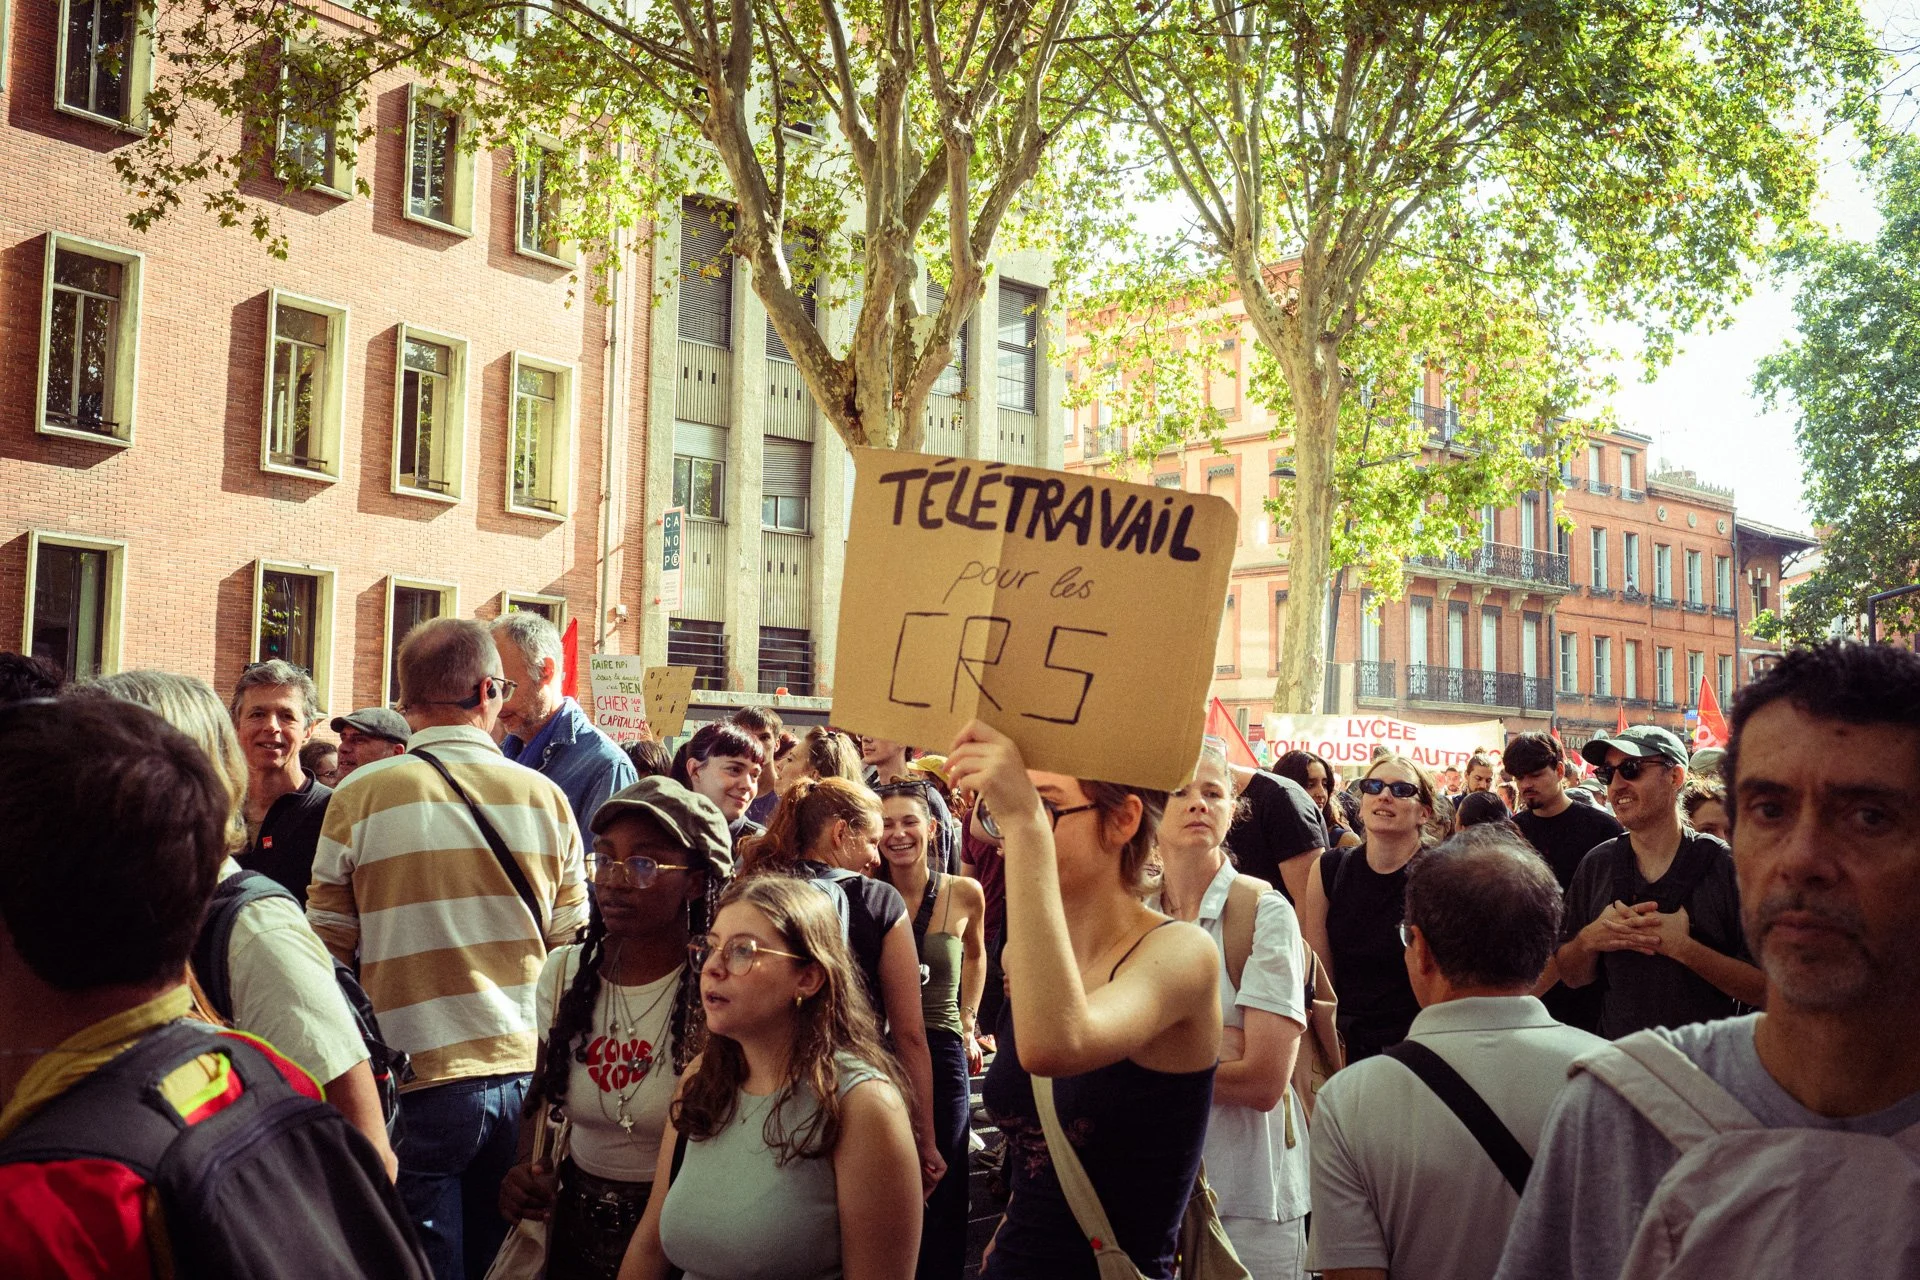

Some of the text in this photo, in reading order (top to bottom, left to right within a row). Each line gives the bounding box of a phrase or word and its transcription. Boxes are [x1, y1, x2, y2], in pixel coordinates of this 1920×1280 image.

[943, 560, 1095, 604] pour les
[889, 612, 1108, 725] CRS
[1347, 719, 1417, 741] LYCEE
[1394, 744, 1502, 767] AUTRC
[585, 1035, 653, 1066] LOVE
